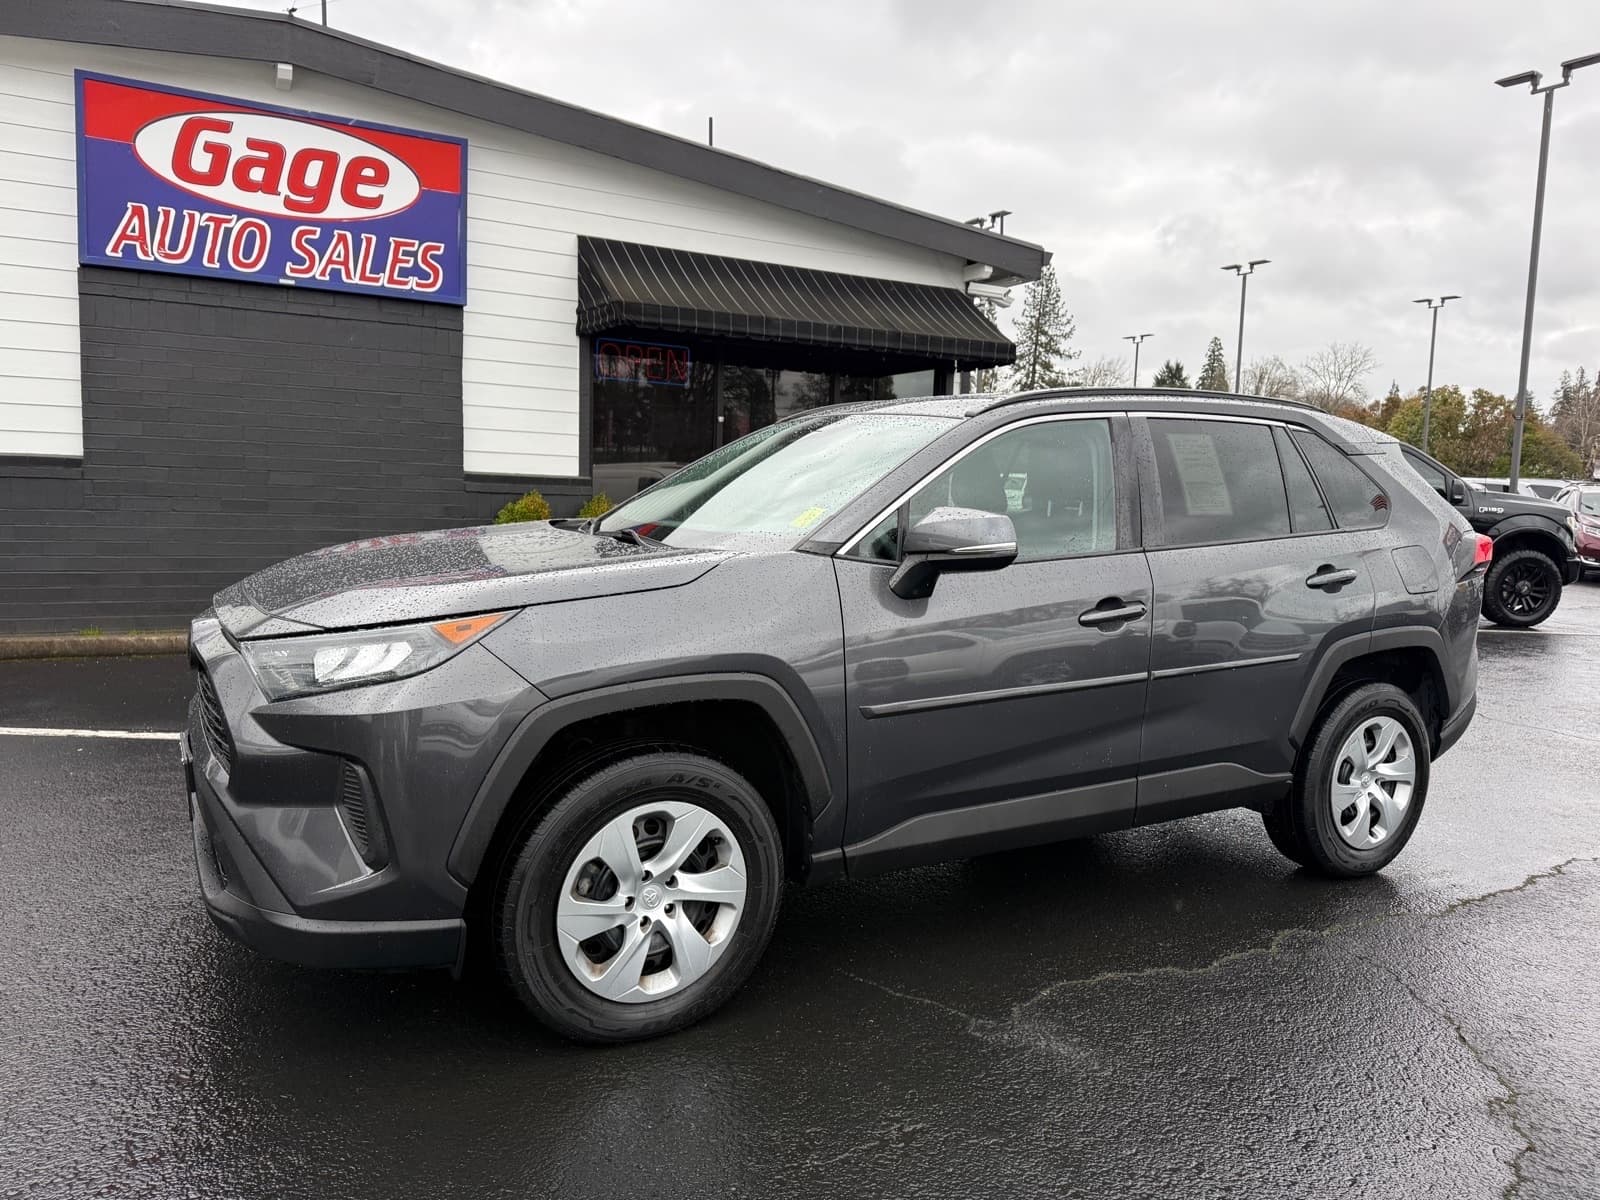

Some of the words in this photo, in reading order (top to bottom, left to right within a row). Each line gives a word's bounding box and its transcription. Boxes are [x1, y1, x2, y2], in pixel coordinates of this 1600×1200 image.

[171, 116, 390, 213] Gage
[106, 202, 271, 272] AUTO
[285, 225, 445, 292] SALES
[600, 343, 687, 381] OPEN
